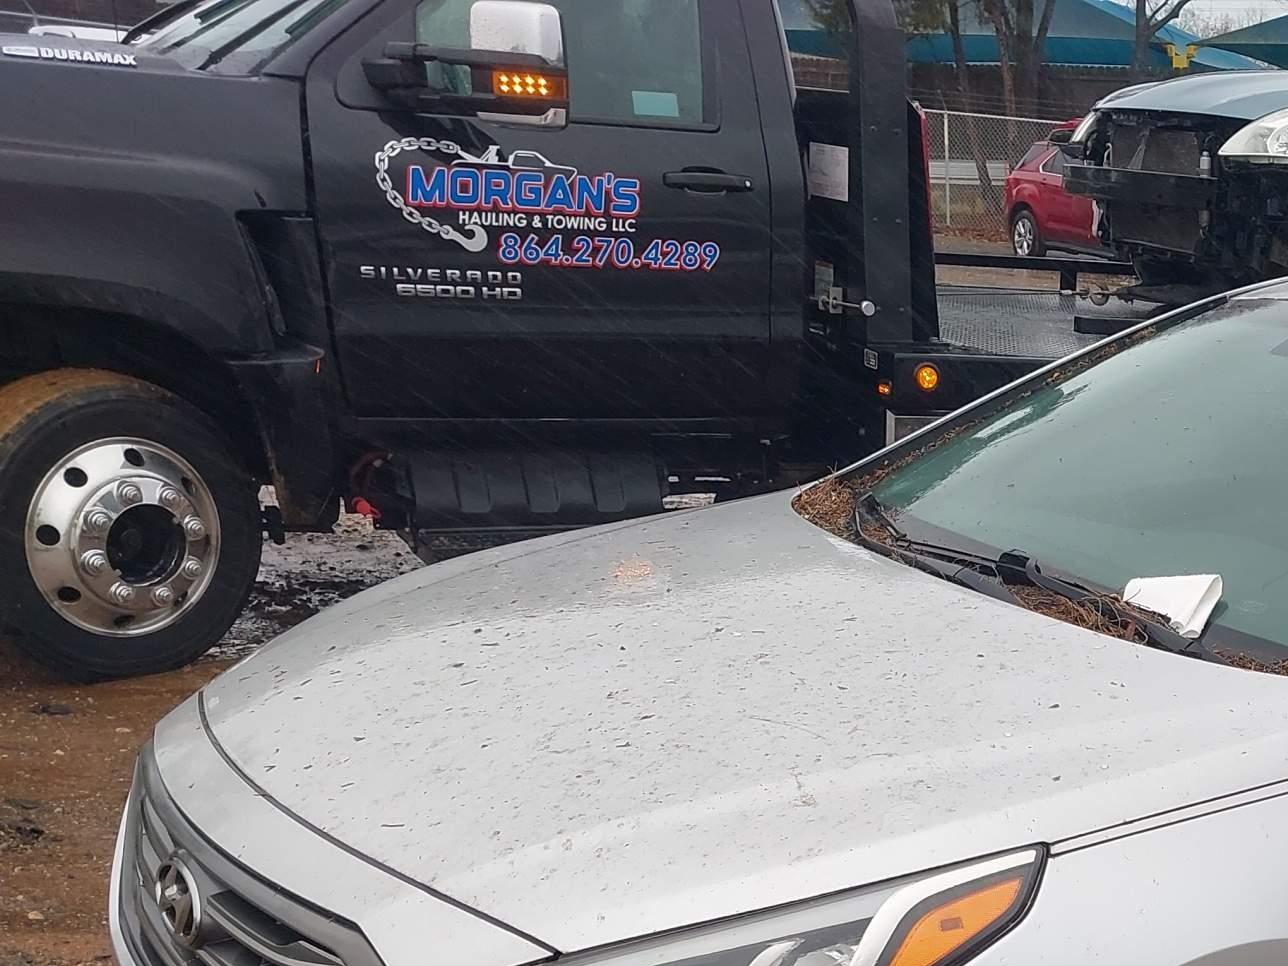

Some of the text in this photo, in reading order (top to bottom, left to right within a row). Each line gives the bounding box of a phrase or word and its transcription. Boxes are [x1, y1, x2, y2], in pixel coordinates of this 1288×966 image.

[40, 47, 137, 65] DURAMAX
[408, 165, 640, 216] MORGAN'S
[458, 211, 637, 233] HAULING & TOWING LLC
[498, 232, 721, 270] 864.270.4289
[360, 265, 522, 285] SILVERADO
[396, 283, 523, 300] 6500 HD
